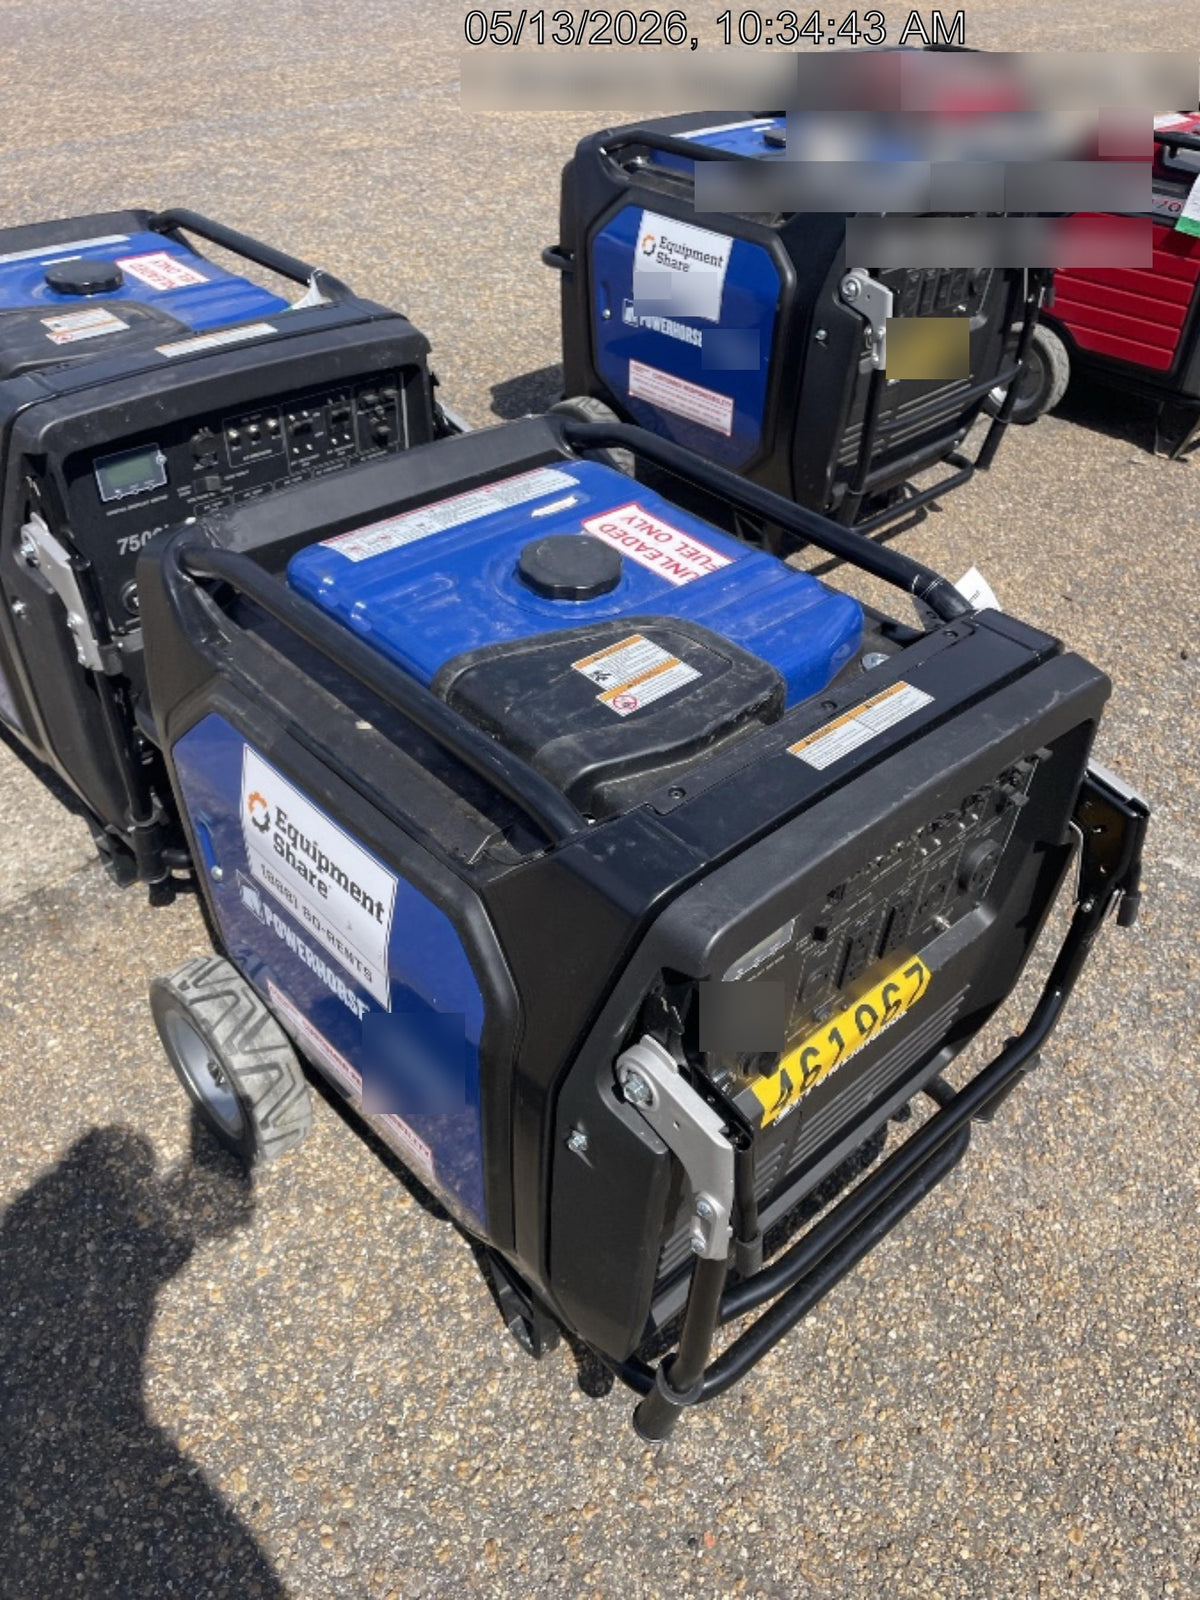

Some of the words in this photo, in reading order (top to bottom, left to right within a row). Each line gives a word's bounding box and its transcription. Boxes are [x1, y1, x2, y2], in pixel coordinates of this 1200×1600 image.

[656, 251, 690, 273] Share
[659, 235, 724, 269] Equipment
[599, 523, 700, 580] UNLEADED
[619, 515, 673, 544] ONLY
[674, 541, 720, 572] FUEL
[273, 832, 328, 900] Share
[275, 805, 385, 925] Equipment
[769, 962, 924, 1114] 461067
